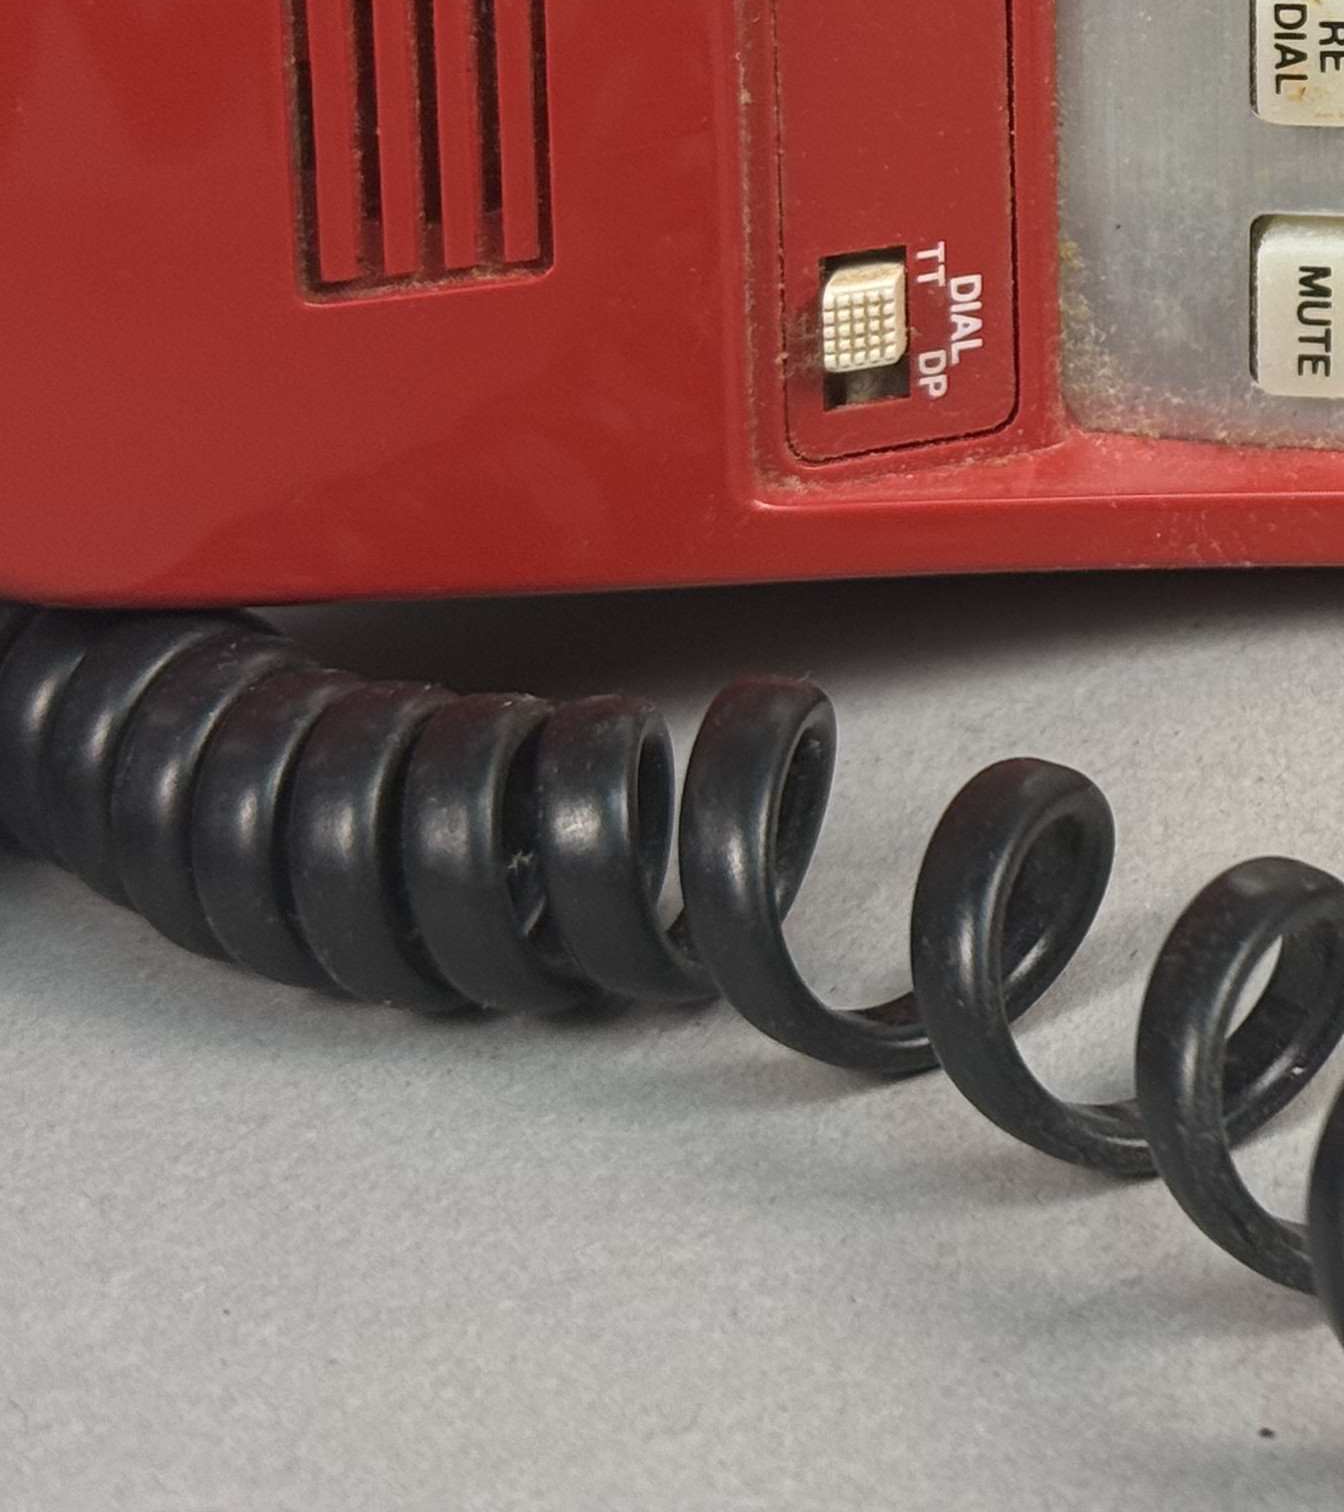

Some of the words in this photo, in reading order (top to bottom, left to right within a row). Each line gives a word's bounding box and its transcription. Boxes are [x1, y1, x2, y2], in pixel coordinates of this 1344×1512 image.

[1271, 2, 1308, 95] DIAL
[916, 241, 946, 287] TT
[949, 274, 984, 366] DIAL
[1297, 265, 1332, 379] MUTE
[918, 349, 948, 398] DP
